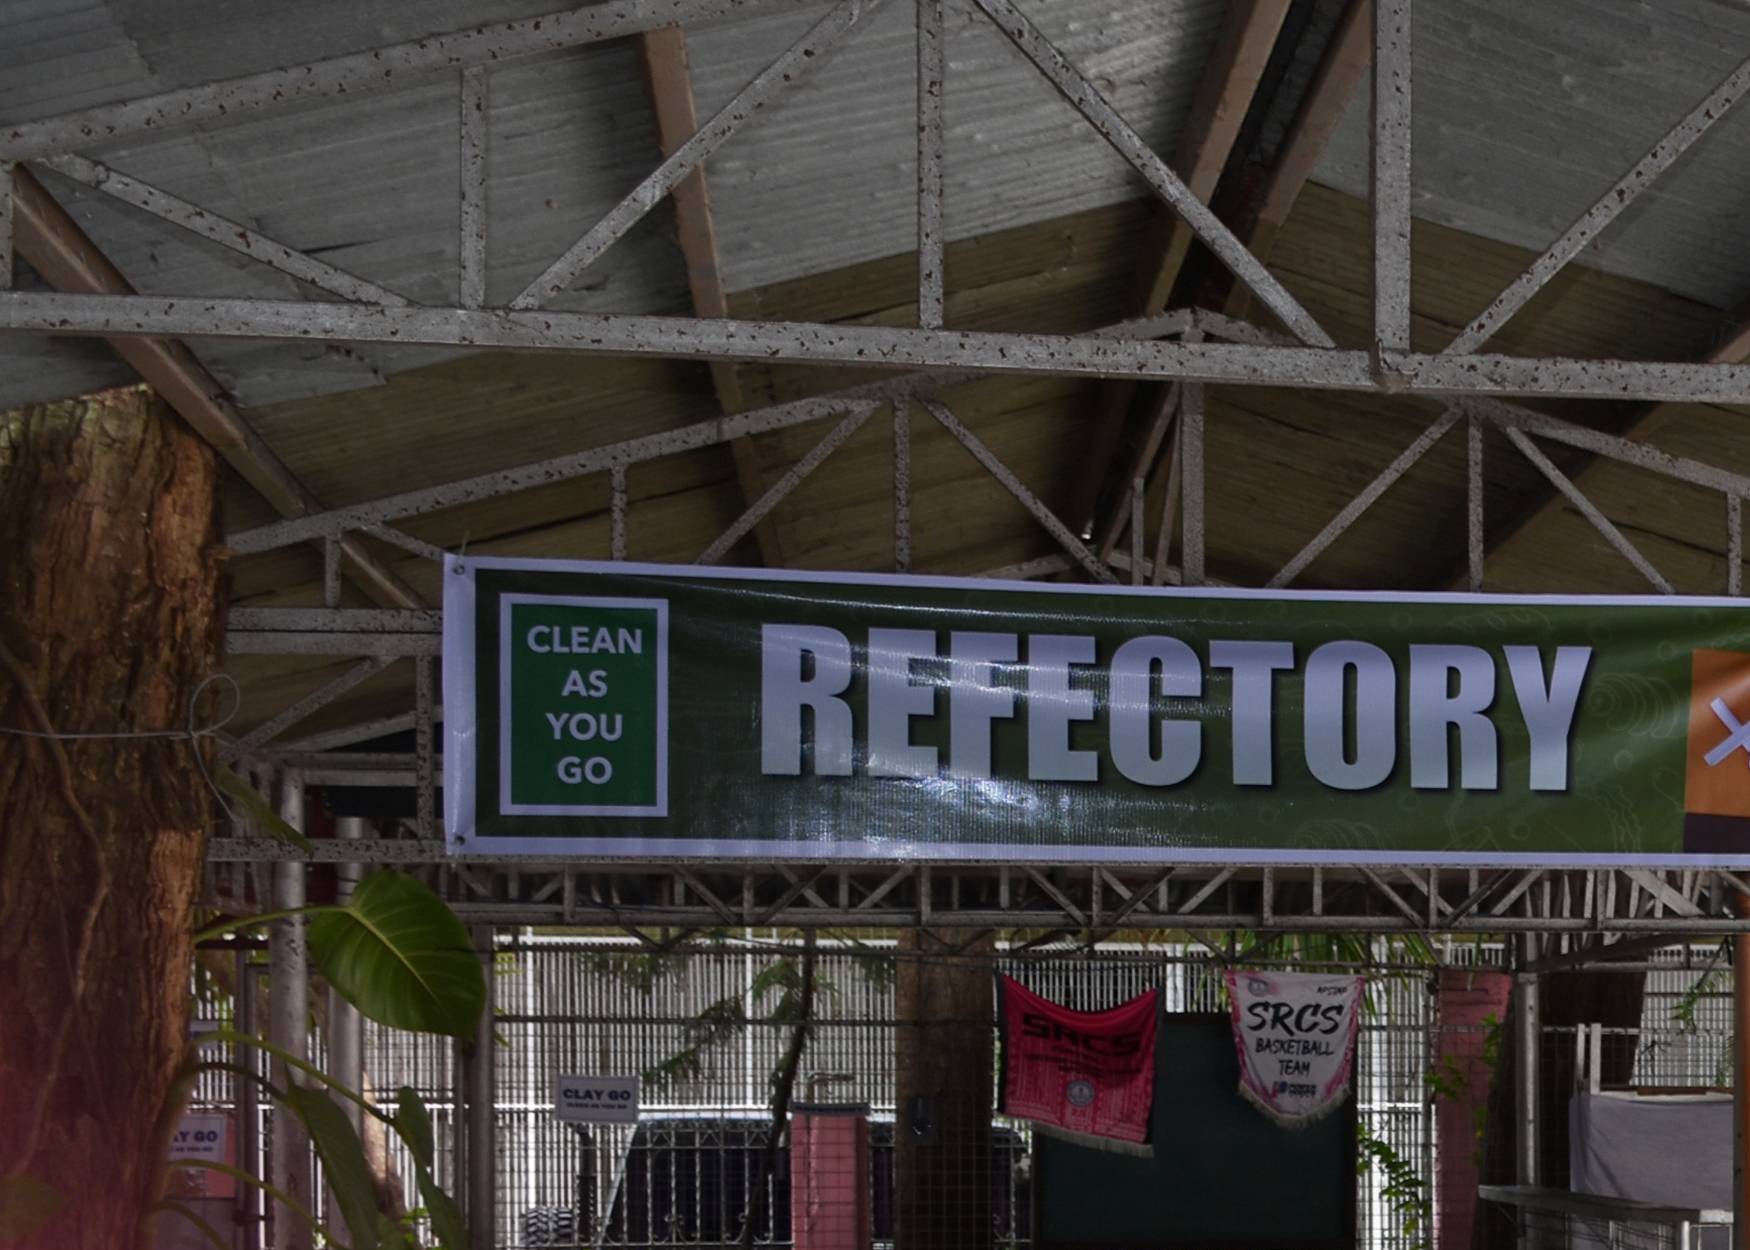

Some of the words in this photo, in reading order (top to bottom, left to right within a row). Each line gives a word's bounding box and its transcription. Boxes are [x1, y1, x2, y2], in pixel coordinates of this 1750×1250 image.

[527, 625, 643, 655] CLEAN
[561, 670, 608, 697] AS
[761, 623, 1592, 791] REFECTORY
[545, 711, 623, 742] YOU
[557, 756, 613, 785] GO
[1247, 1001, 1344, 1036] SRCS
[1256, 1038, 1334, 1055] BASKETBALL
[1278, 1060, 1310, 1076] TEAM
[563, 1088, 604, 1101] CLAY
[608, 1089, 631, 1101] GO
[194, 1130, 218, 1143] GO
